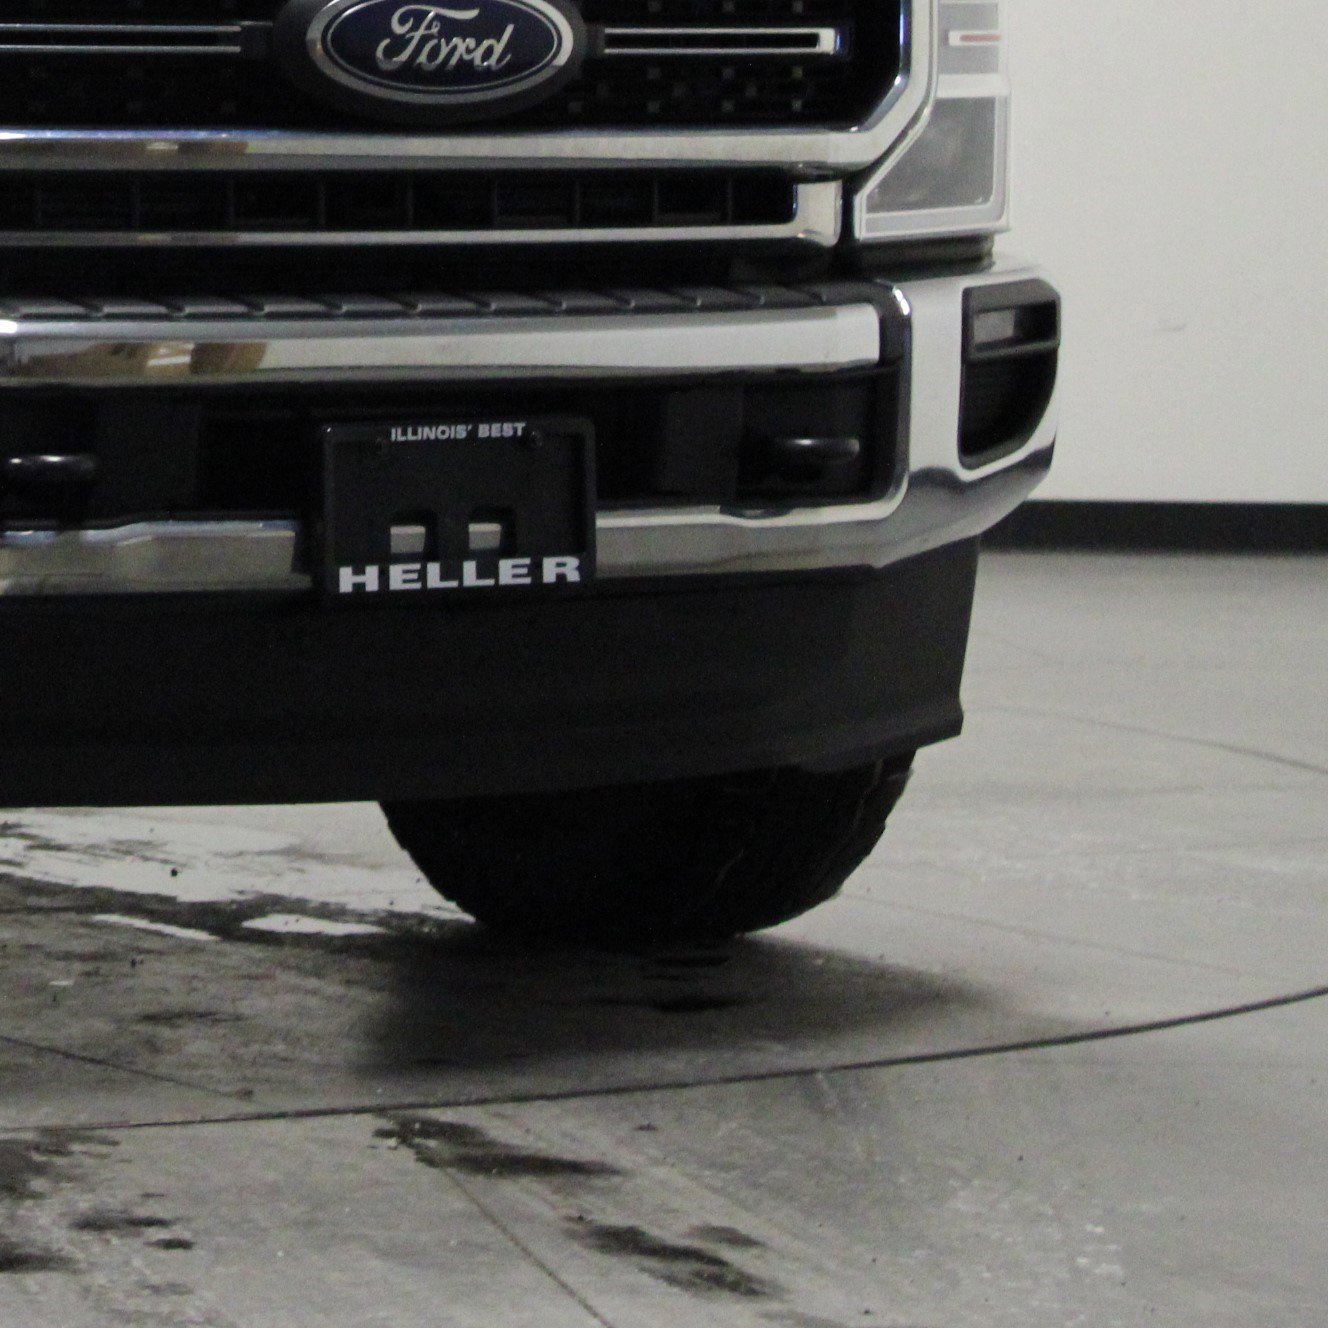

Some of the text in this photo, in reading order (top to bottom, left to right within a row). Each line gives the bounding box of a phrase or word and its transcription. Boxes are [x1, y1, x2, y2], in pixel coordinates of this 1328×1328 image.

[375, 4, 515, 71] Ford
[477, 422, 527, 439] BEST
[338, 556, 582, 594] HELLER
